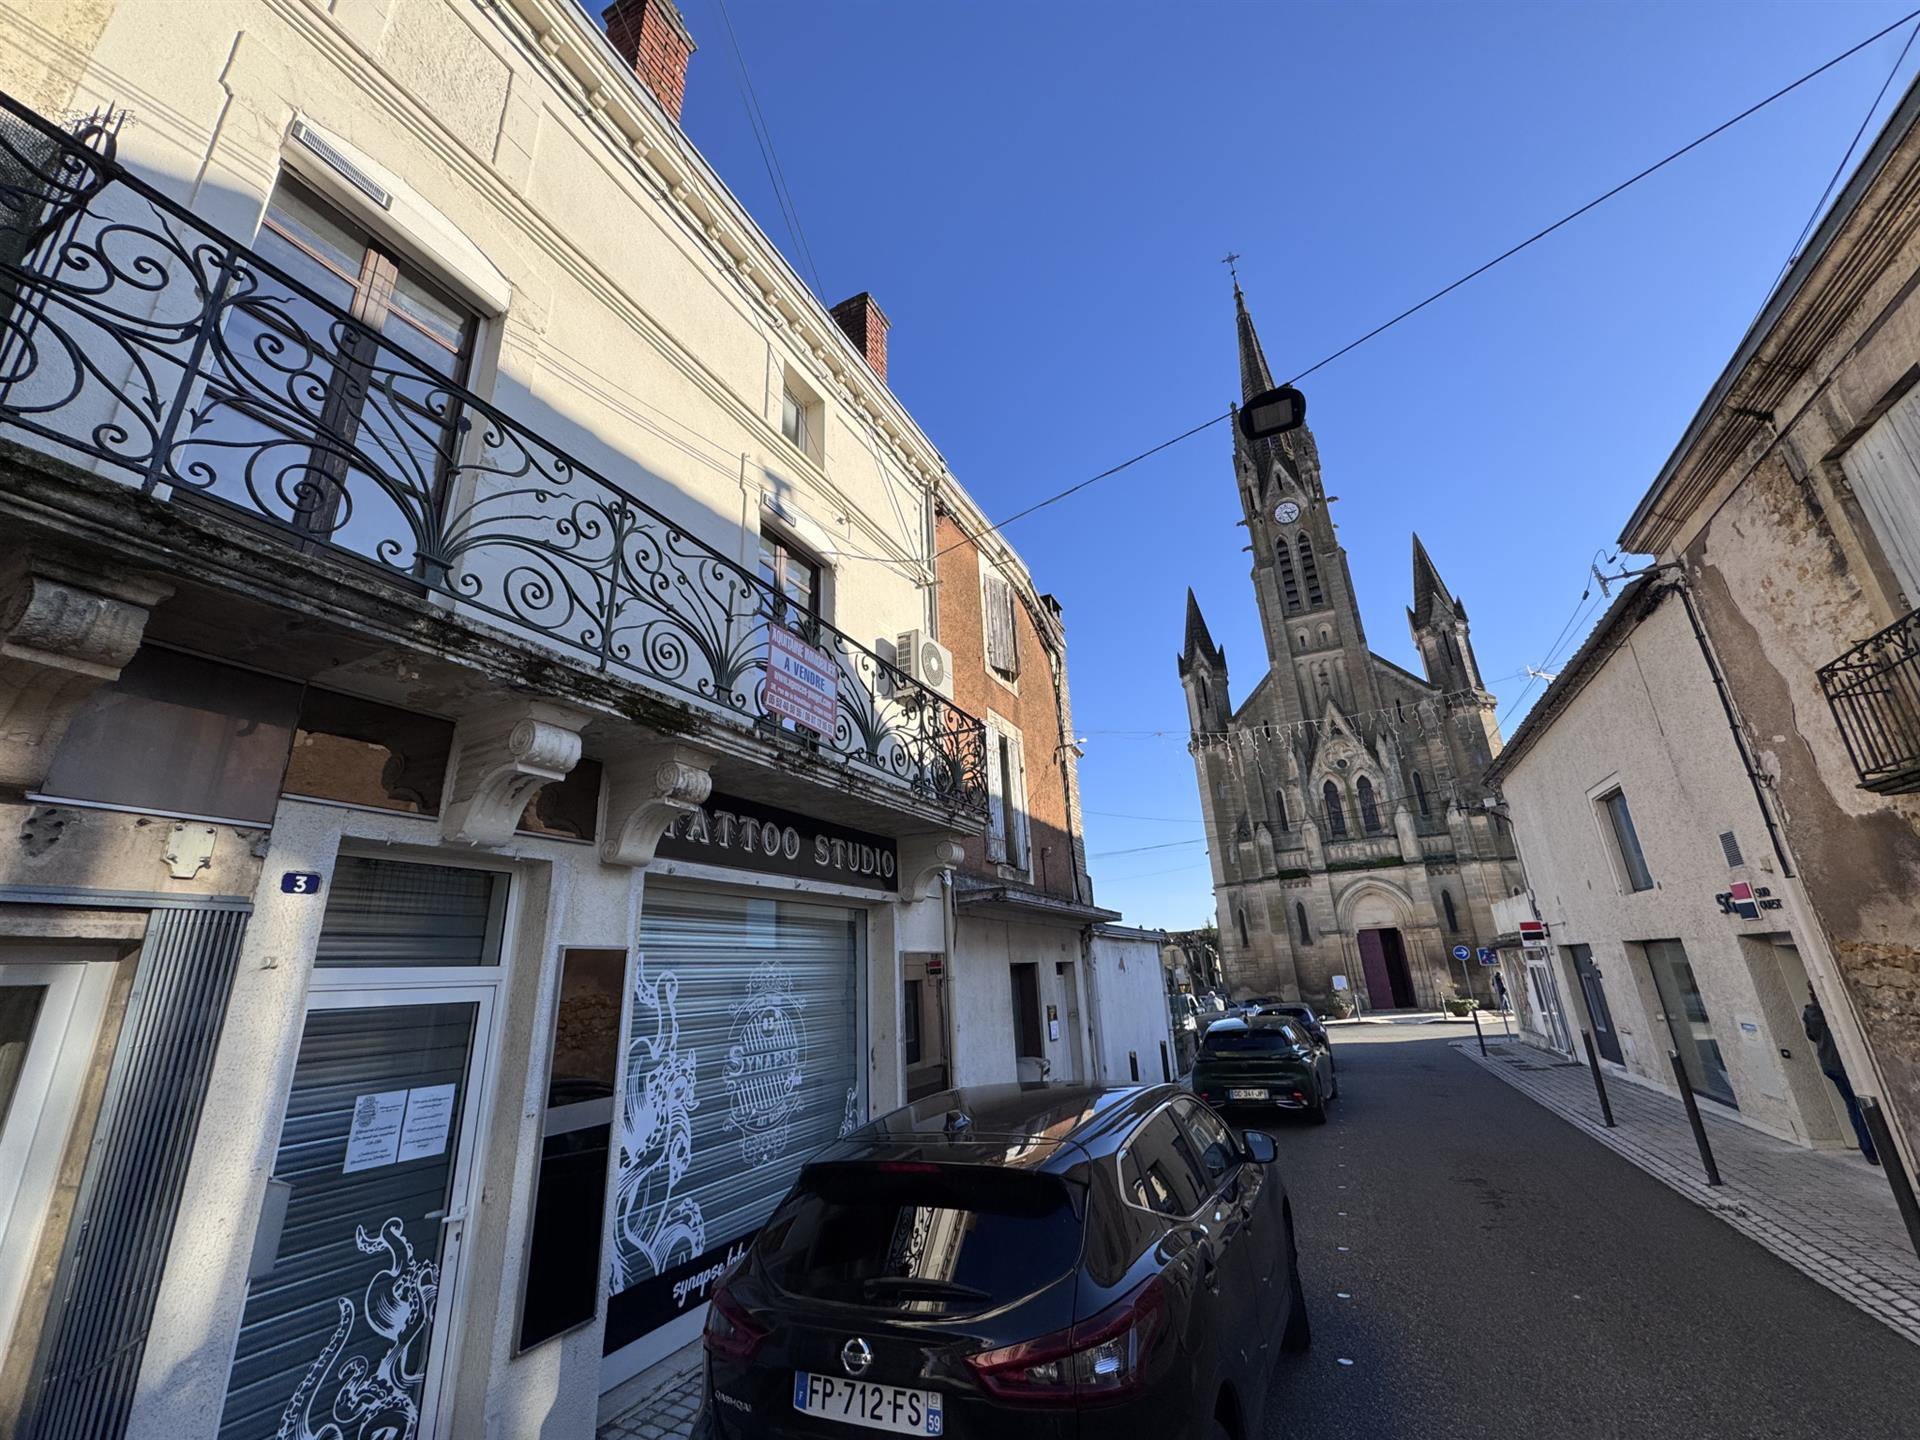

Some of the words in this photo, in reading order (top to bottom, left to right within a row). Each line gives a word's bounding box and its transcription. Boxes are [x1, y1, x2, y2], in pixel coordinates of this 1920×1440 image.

[784, 656, 790, 672] A
[794, 661, 825, 692] VENDRE
[814, 833, 896, 879] STUDIO
[294, 875, 307, 893] 3
[1754, 887, 1771, 898] SUD
[1759, 899, 1783, 910] OUEST
[673, 1262, 725, 1308] synapse
[808, 1375, 921, 1426] FP-712-FS
[928, 1415, 941, 1432] 59
